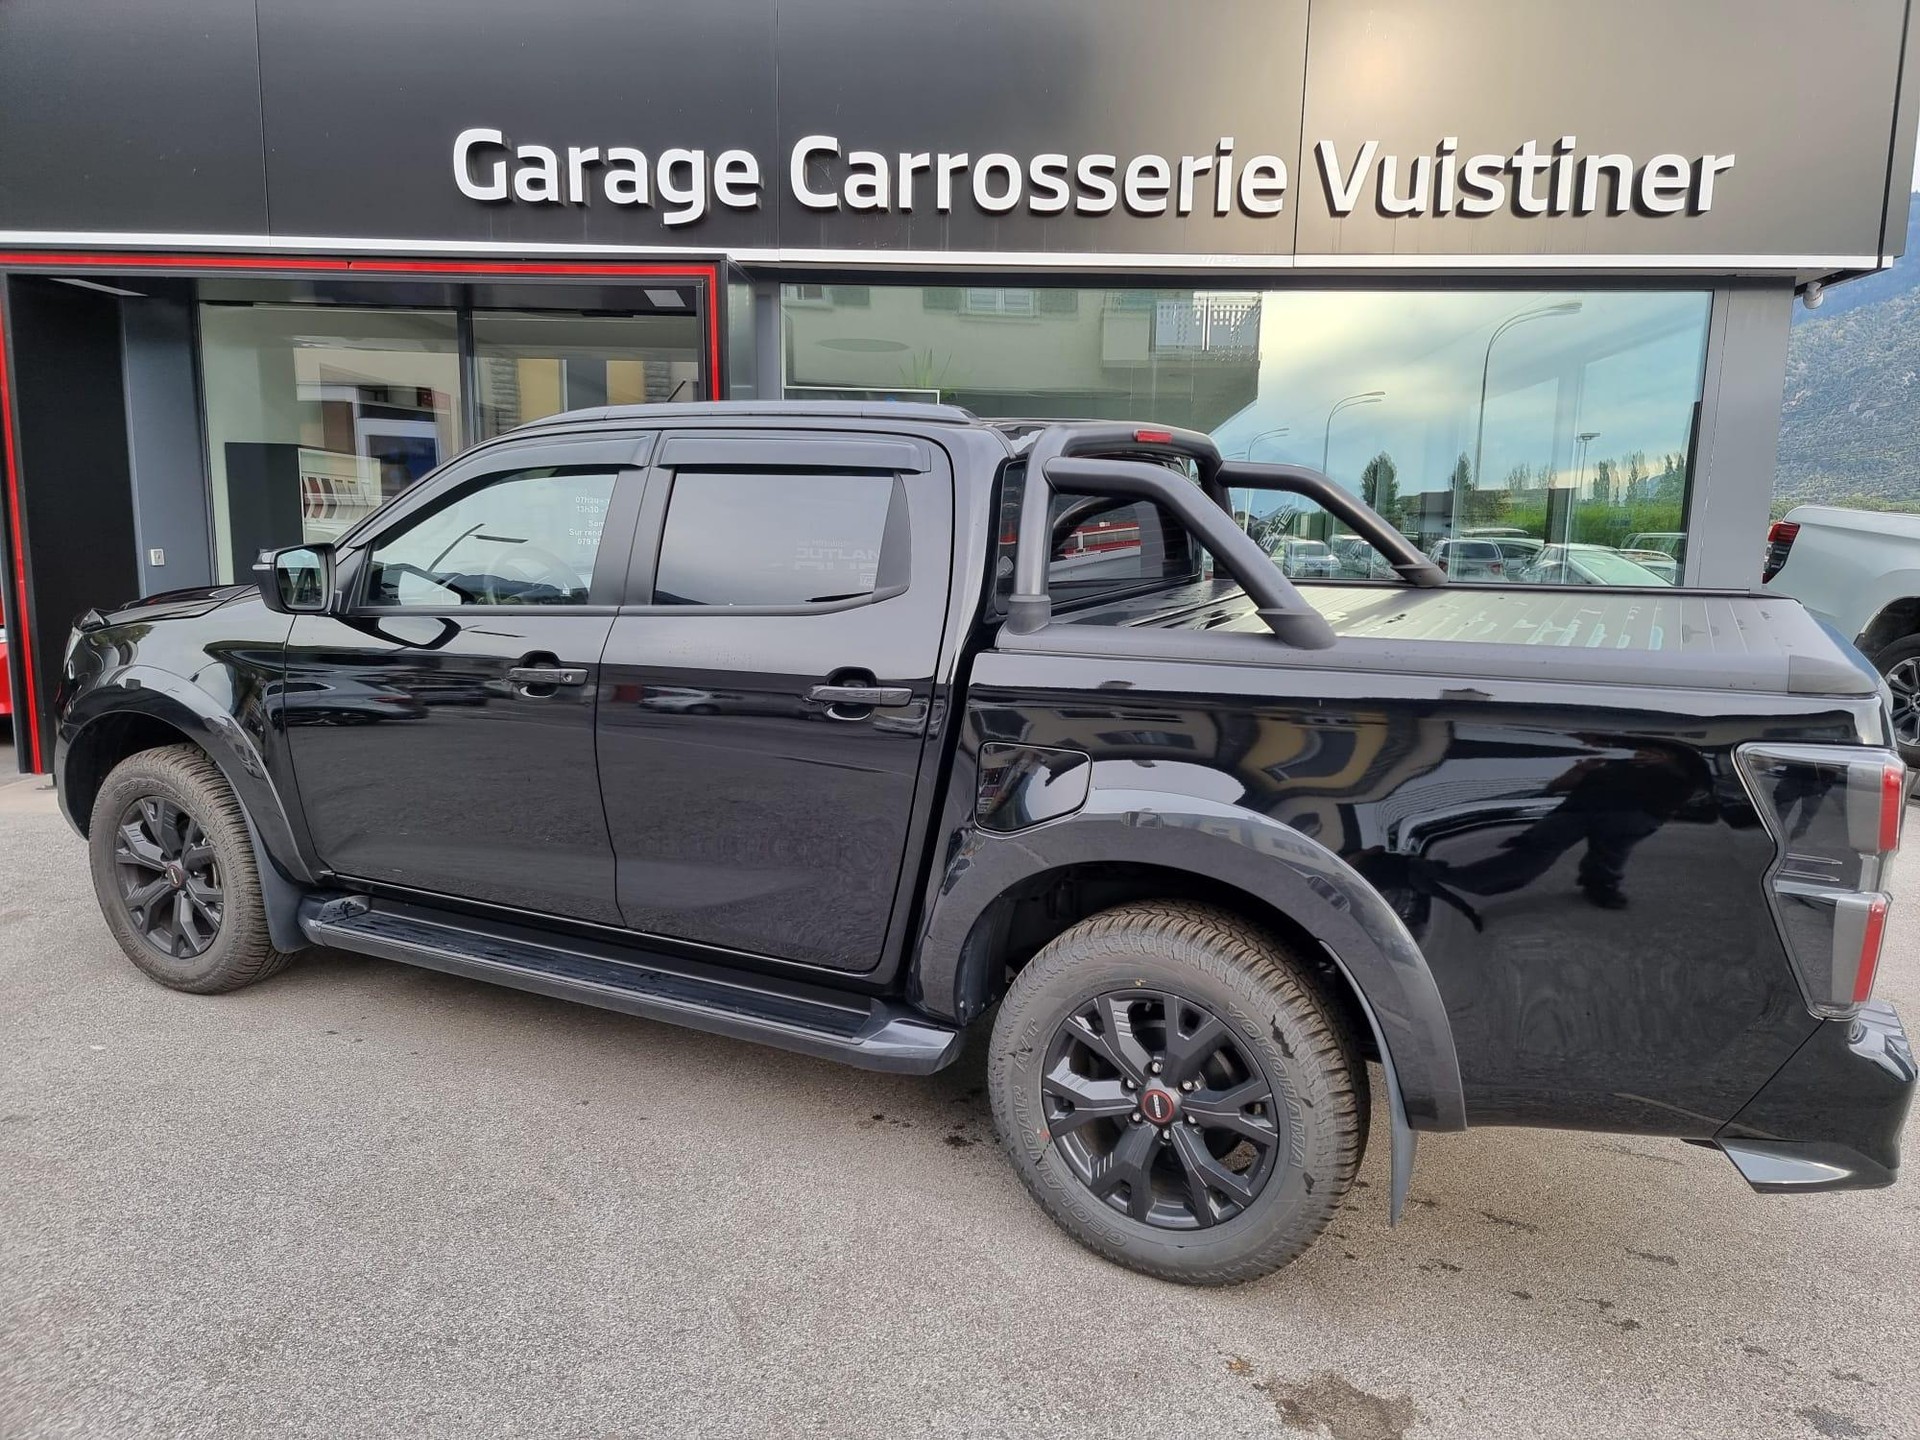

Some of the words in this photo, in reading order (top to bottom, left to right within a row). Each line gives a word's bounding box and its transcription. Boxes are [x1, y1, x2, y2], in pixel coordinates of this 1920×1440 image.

[453, 127, 763, 227] Garage
[790, 134, 1288, 215] Carrosserie
[1315, 134, 1736, 216] Vuistiner
[1228, 1001, 1305, 1168] YOKOHAMA
[1012, 1085, 1130, 1248] GEOLANDAR
